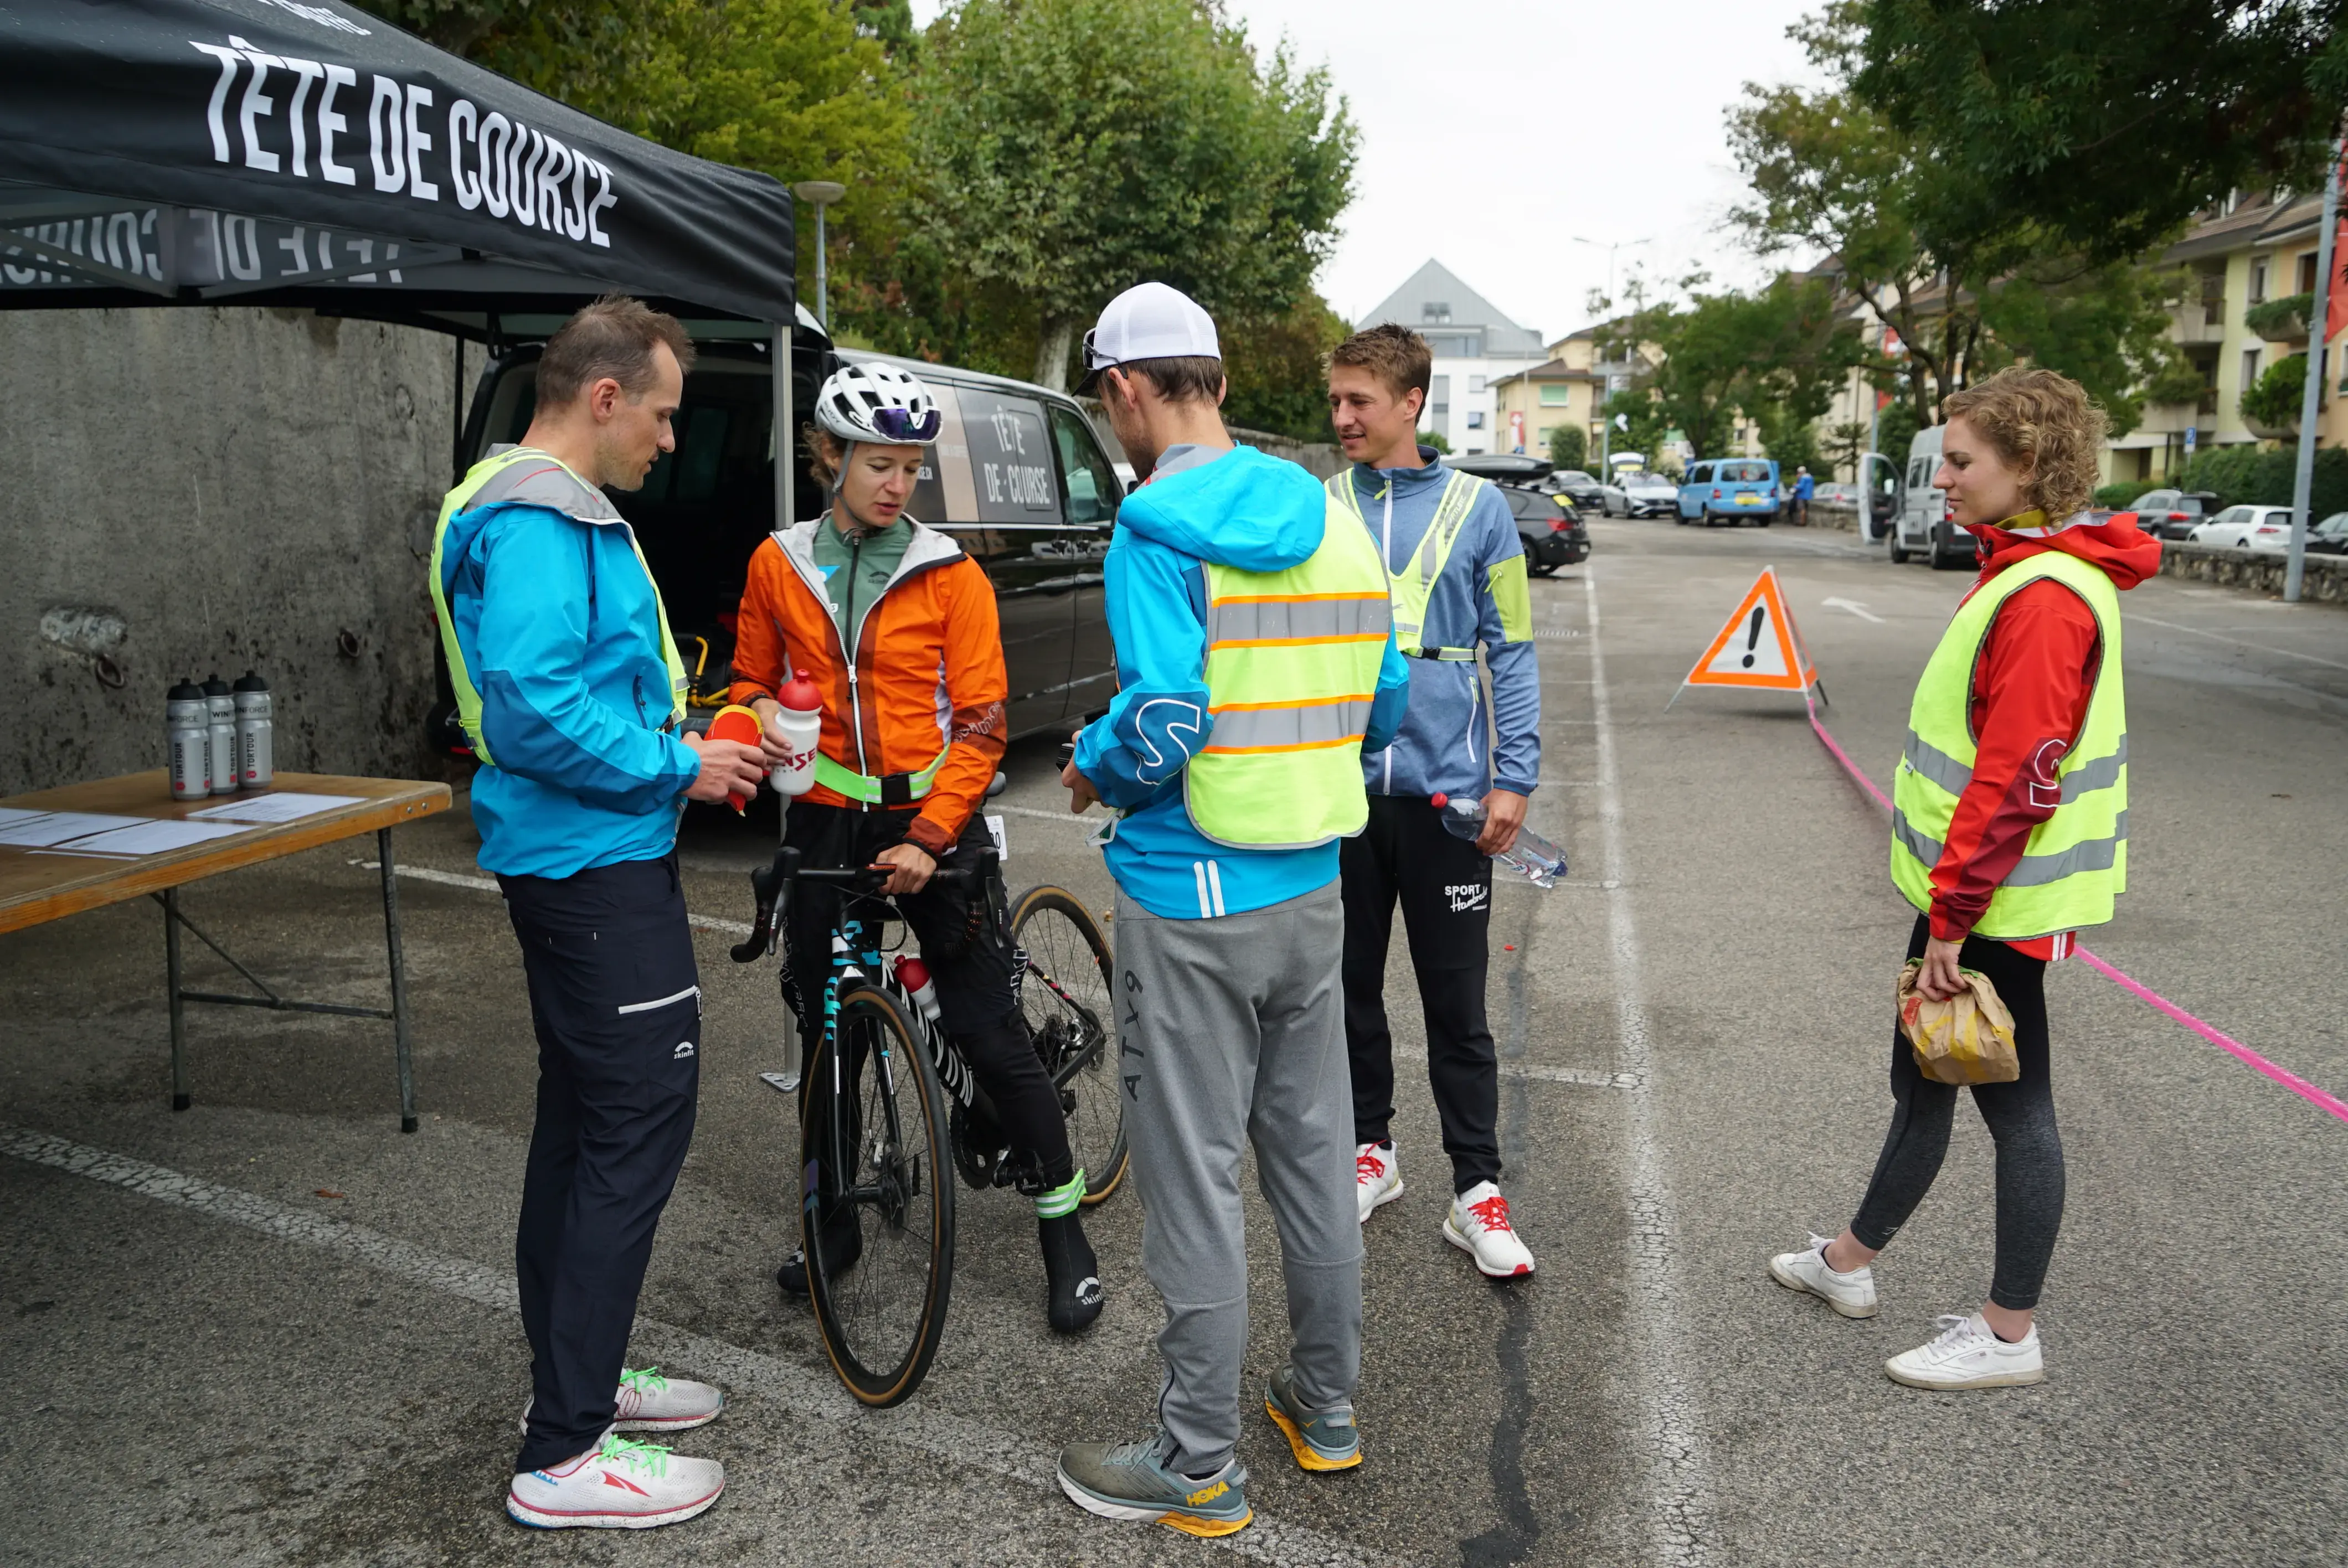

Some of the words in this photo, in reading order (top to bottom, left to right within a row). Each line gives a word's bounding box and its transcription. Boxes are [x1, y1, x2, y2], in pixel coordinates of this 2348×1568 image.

[188, 35, 356, 186] TÊTE
[368, 73, 439, 200] DE
[449, 100, 619, 249] COURSE
[991, 404, 1026, 455] TÊTE
[984, 463, 1004, 503] DE
[1007, 463, 1051, 505] COURSE
[174, 742, 184, 780] TORTOUR
[246, 732, 255, 768] TORTOUR
[1444, 884, 1481, 896] SPORT
[673, 1049, 694, 1060] skinfit
[1186, 1480, 1229, 1507] HOKA
